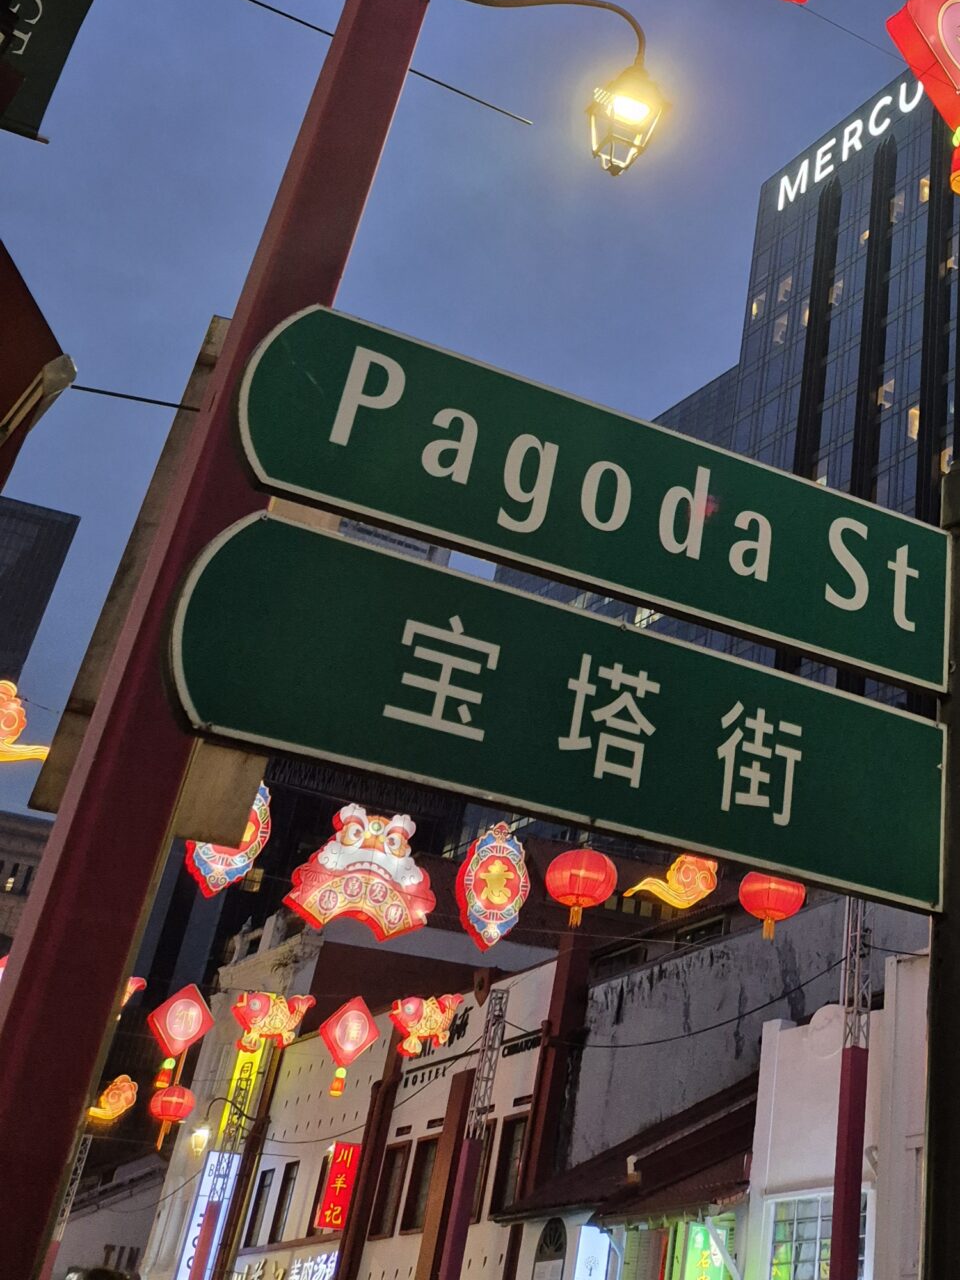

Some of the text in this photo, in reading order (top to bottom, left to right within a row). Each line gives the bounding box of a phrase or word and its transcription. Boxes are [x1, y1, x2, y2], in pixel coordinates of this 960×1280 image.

[776, 81, 925, 211] MERCU
[328, 346, 919, 632] Pagoda St
[382, 615, 801, 826] 宝塔街
[324, 1148, 354, 1225] 川羊记
